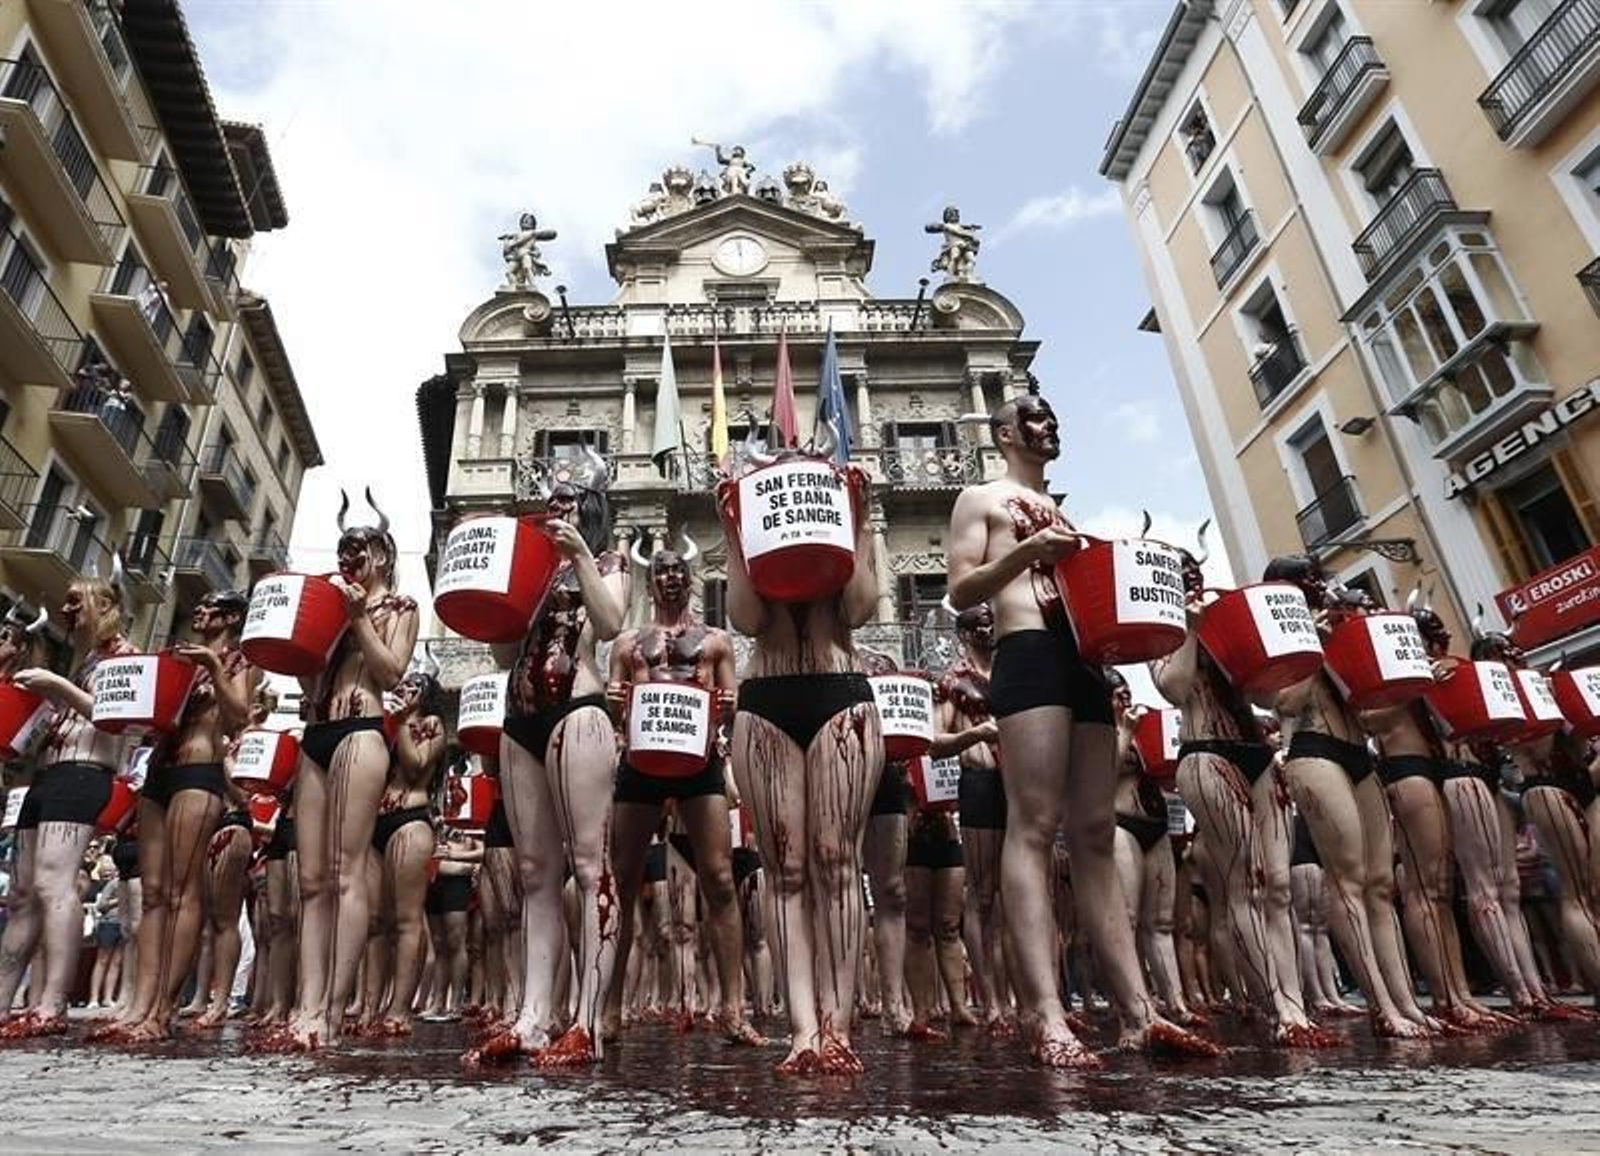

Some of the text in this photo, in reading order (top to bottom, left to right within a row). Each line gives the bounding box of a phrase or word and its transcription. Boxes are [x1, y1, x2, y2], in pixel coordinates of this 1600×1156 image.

[755, 475, 783, 496] SAN
[769, 492, 788, 510] SE
[763, 508, 842, 530] DE SANGRE
[451, 556, 488, 572] BULLS
[1529, 562, 1593, 601] EROSKI
[1383, 623, 1405, 635] SAN
[1395, 649, 1411, 660] DE
[879, 683, 898, 694] SAN
[99, 690, 137, 704] SANGRE
[641, 692, 660, 704] SAN
[888, 695, 900, 706] SE
[647, 706, 660, 718] SE
[883, 708, 895, 719] DE
[641, 719, 698, 736] DE SANGRE
